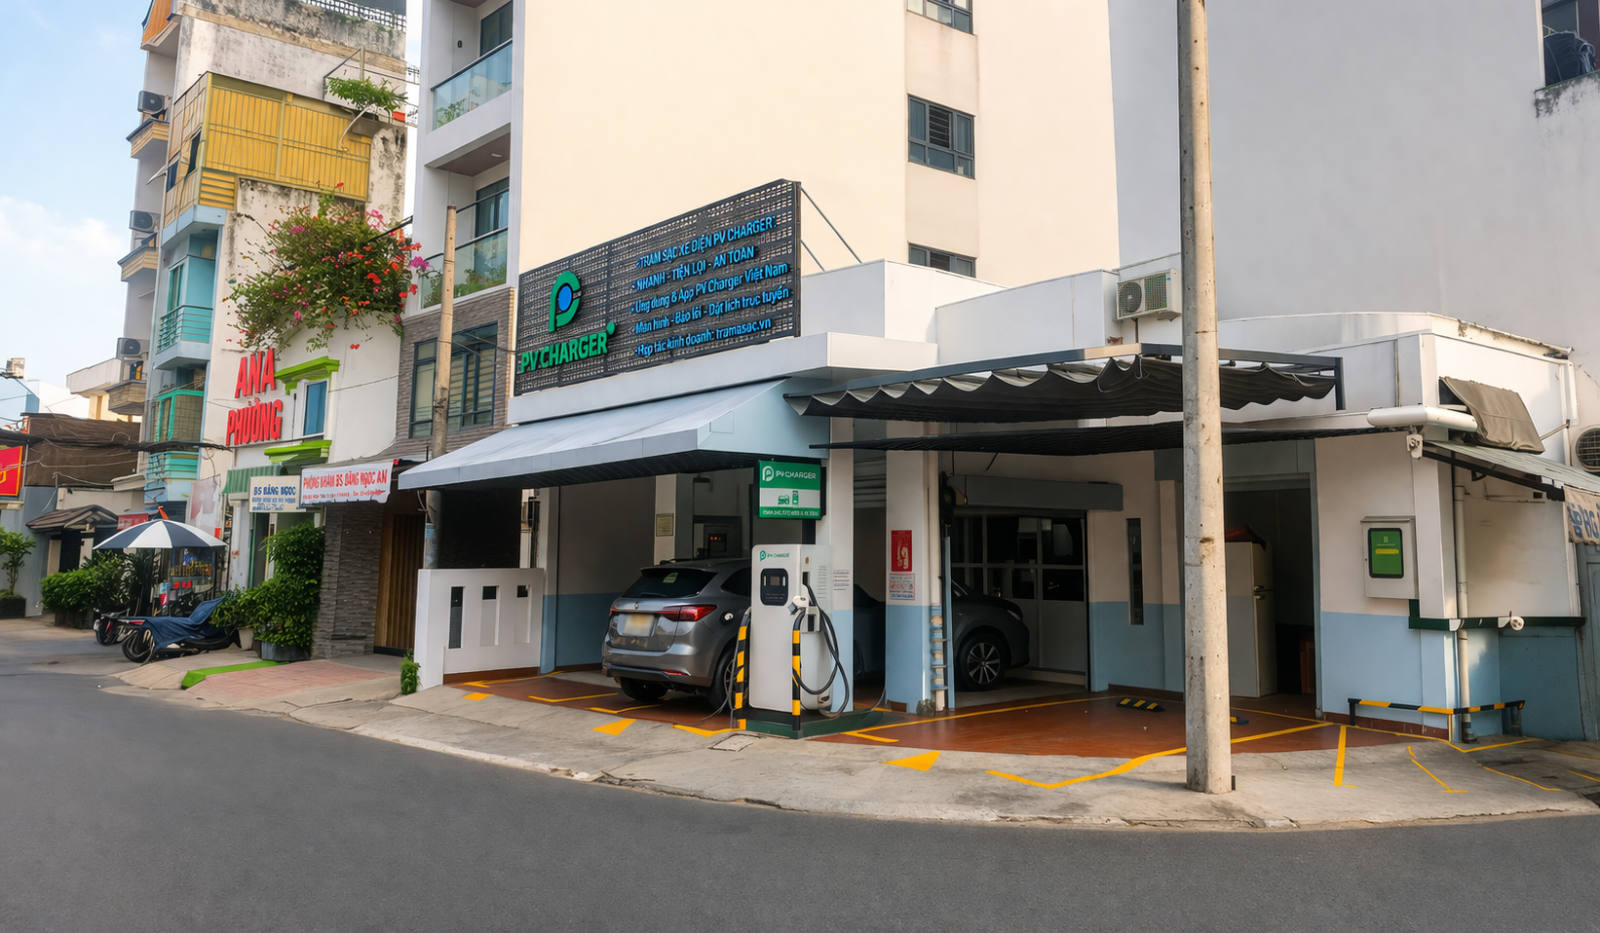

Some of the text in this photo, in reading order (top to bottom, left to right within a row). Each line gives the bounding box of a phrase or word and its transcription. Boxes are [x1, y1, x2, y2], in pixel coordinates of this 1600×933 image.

[679, 241, 691, 256] XE
[713, 230, 726, 246] PV
[713, 253, 727, 269] AN
[696, 280, 708, 296] PV
[708, 274, 743, 292] Charger
[764, 263, 788, 278] Nam
[521, 332, 608, 373] PV CHARGER
[235, 348, 276, 399] ANA
[376, 469, 388, 484] AN
[775, 470, 817, 480] PV CHARGER
